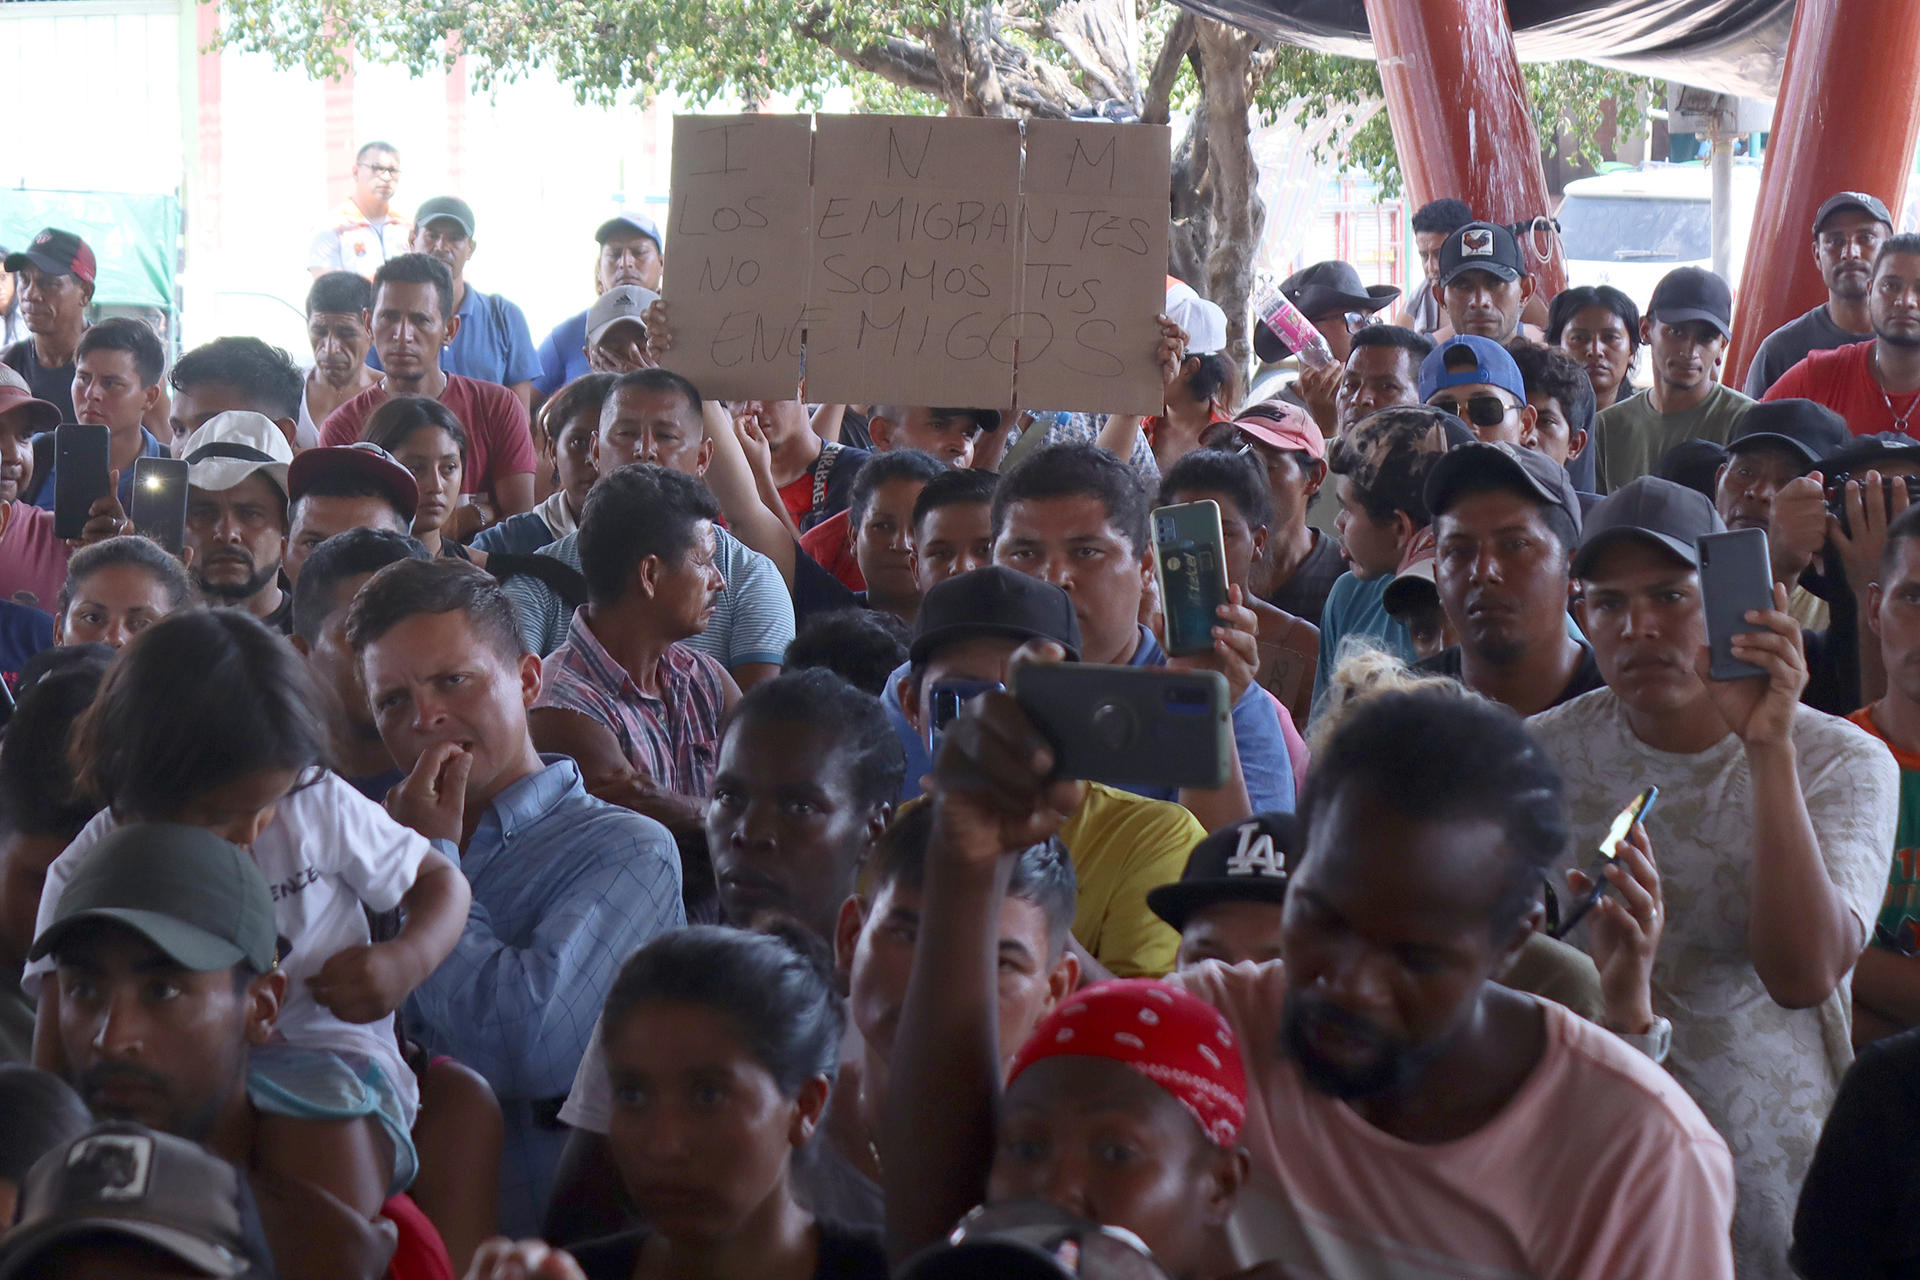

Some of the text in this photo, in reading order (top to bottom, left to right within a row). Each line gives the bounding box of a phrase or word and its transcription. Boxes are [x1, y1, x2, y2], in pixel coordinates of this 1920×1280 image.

[887, 126, 932, 179] N
[1065, 136, 1116, 188] M
[678, 194, 1151, 256] LOS EMIGRANTES
[699, 257, 761, 293] NO
[823, 253, 992, 300] SOMOS
[710, 302, 1126, 377] ENEMIGOS
[1227, 822, 1287, 878] LA
